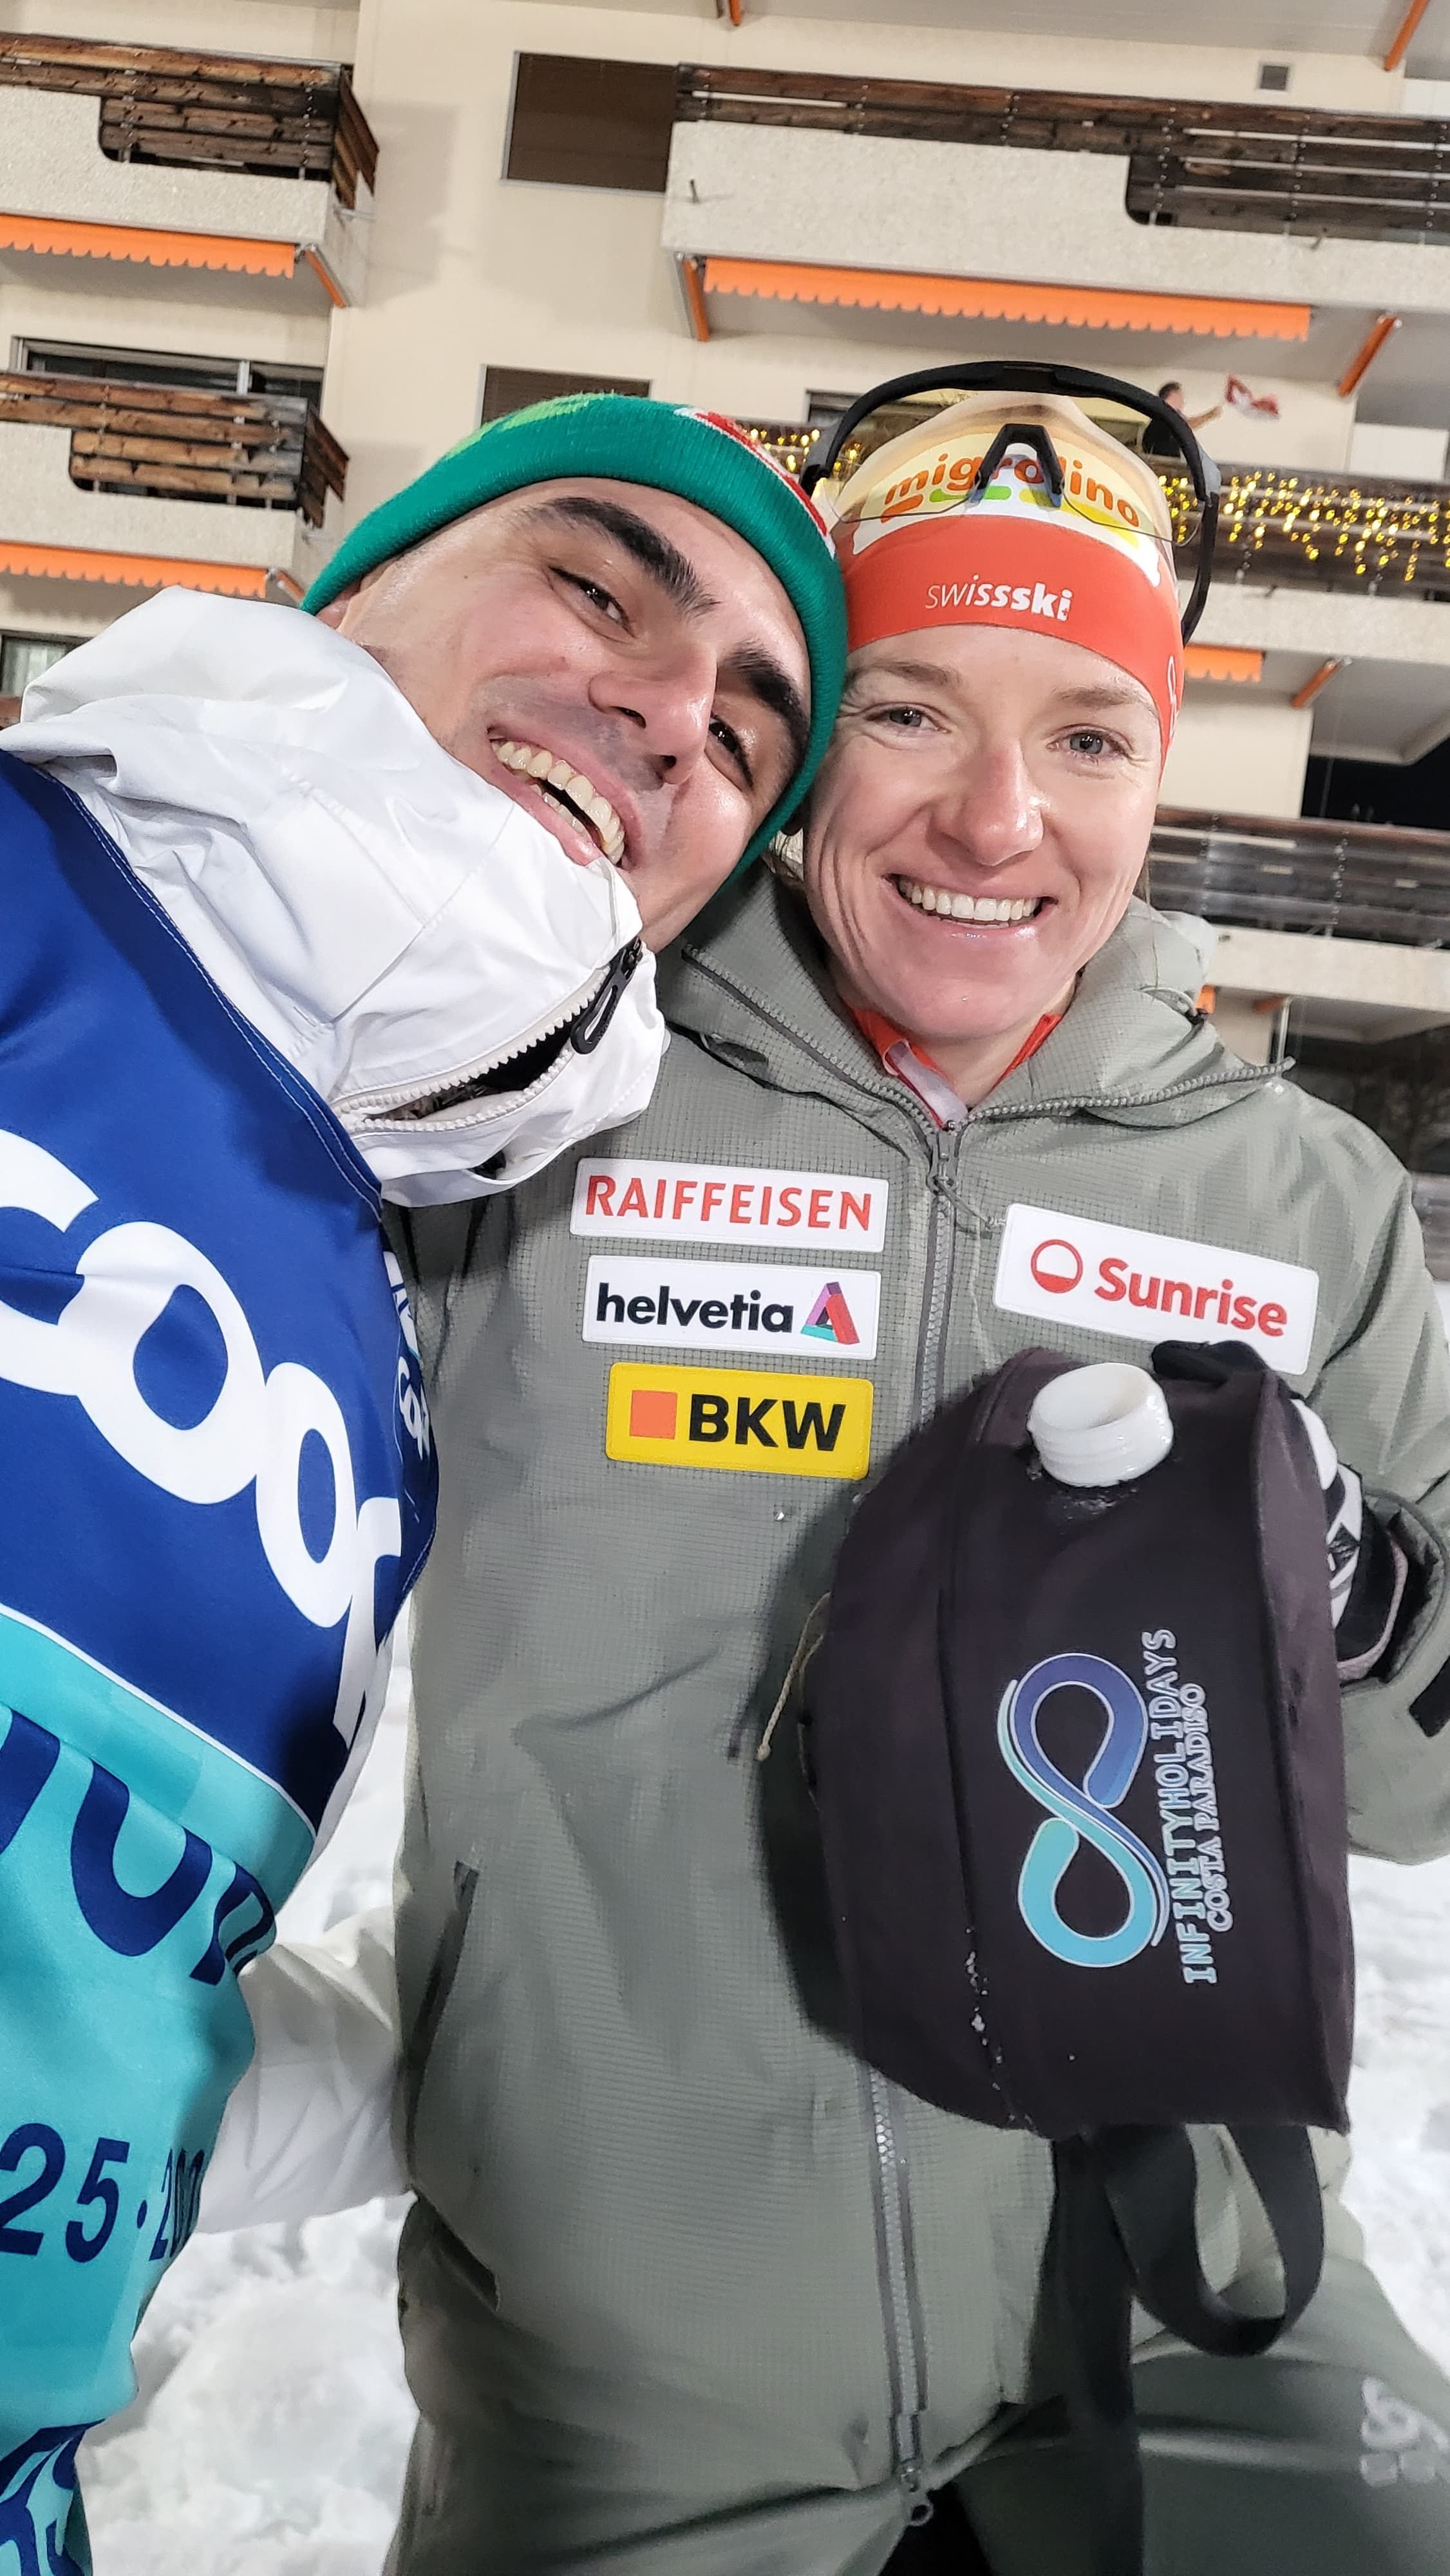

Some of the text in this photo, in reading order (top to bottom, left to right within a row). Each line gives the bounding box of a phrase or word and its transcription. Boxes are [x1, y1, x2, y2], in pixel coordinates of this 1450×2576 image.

[925, 574, 1073, 621] swissski
[585, 1175, 872, 1231] RAIFFEISEN
[596, 1282, 794, 1333] helvetia
[1094, 1257, 1288, 1337] Sunrise
[688, 1393, 847, 1452] BKW
[1180, 1682, 1234, 1932] COSTA PARADISO
